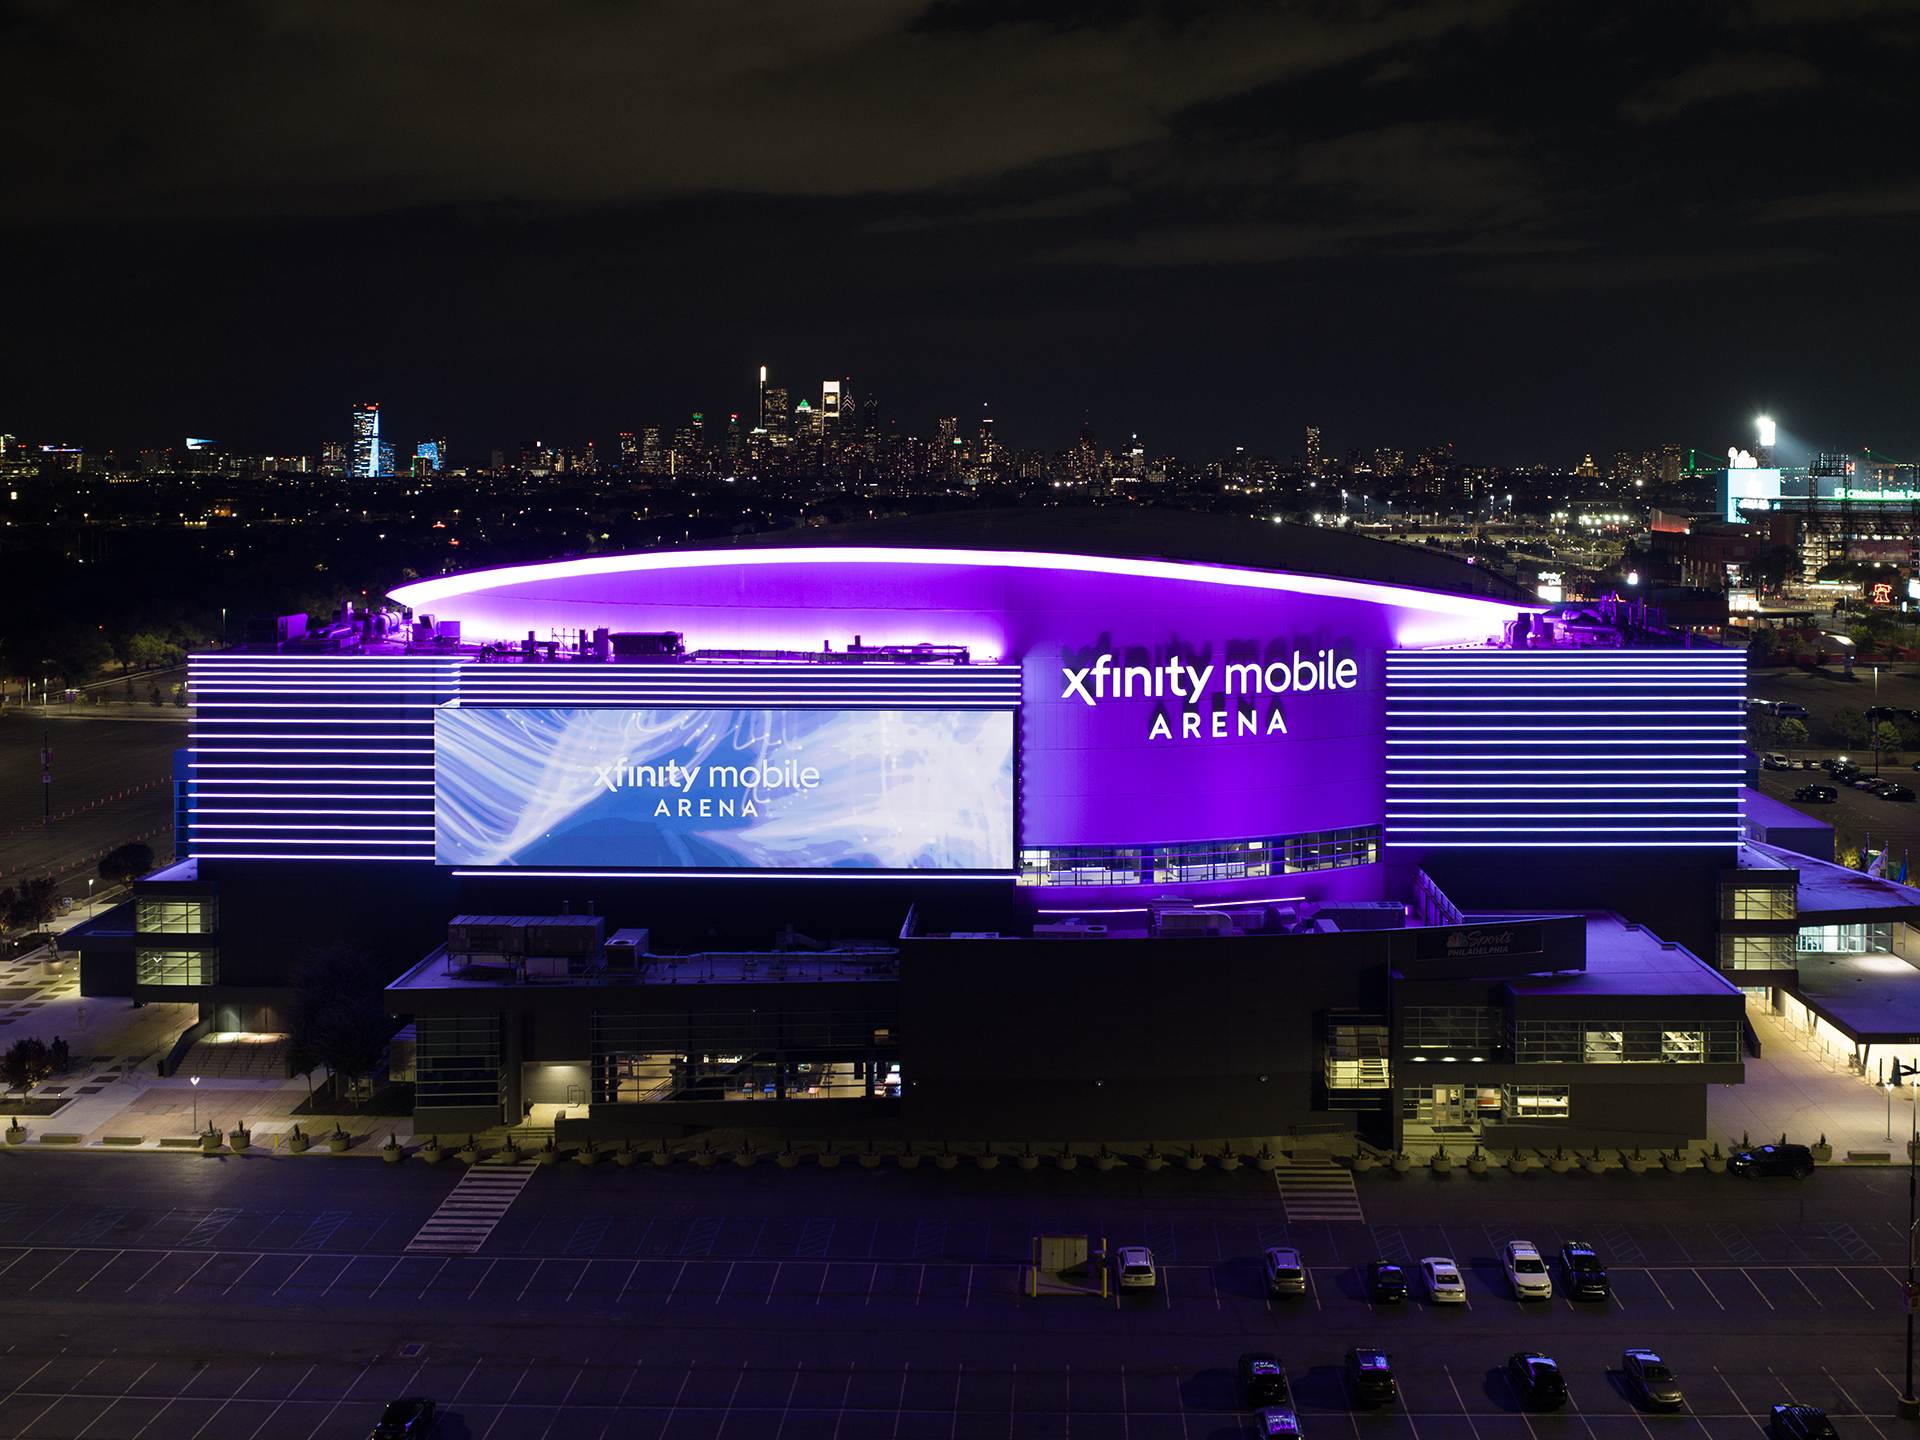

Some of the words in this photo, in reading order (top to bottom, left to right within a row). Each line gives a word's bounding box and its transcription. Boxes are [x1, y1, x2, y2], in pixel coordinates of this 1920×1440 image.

[1883, 489, 1906, 499] Bank
[1061, 654, 1214, 706] xfinity
[1225, 649, 1358, 694] mobile
[1149, 709, 1287, 740] ARENA
[594, 757, 701, 792] xfinity
[709, 758, 820, 788] mobile
[654, 799, 759, 817] ARENA
[1467, 930, 1514, 948] Sports
[1447, 946, 1508, 957] PHILADELPHIA
